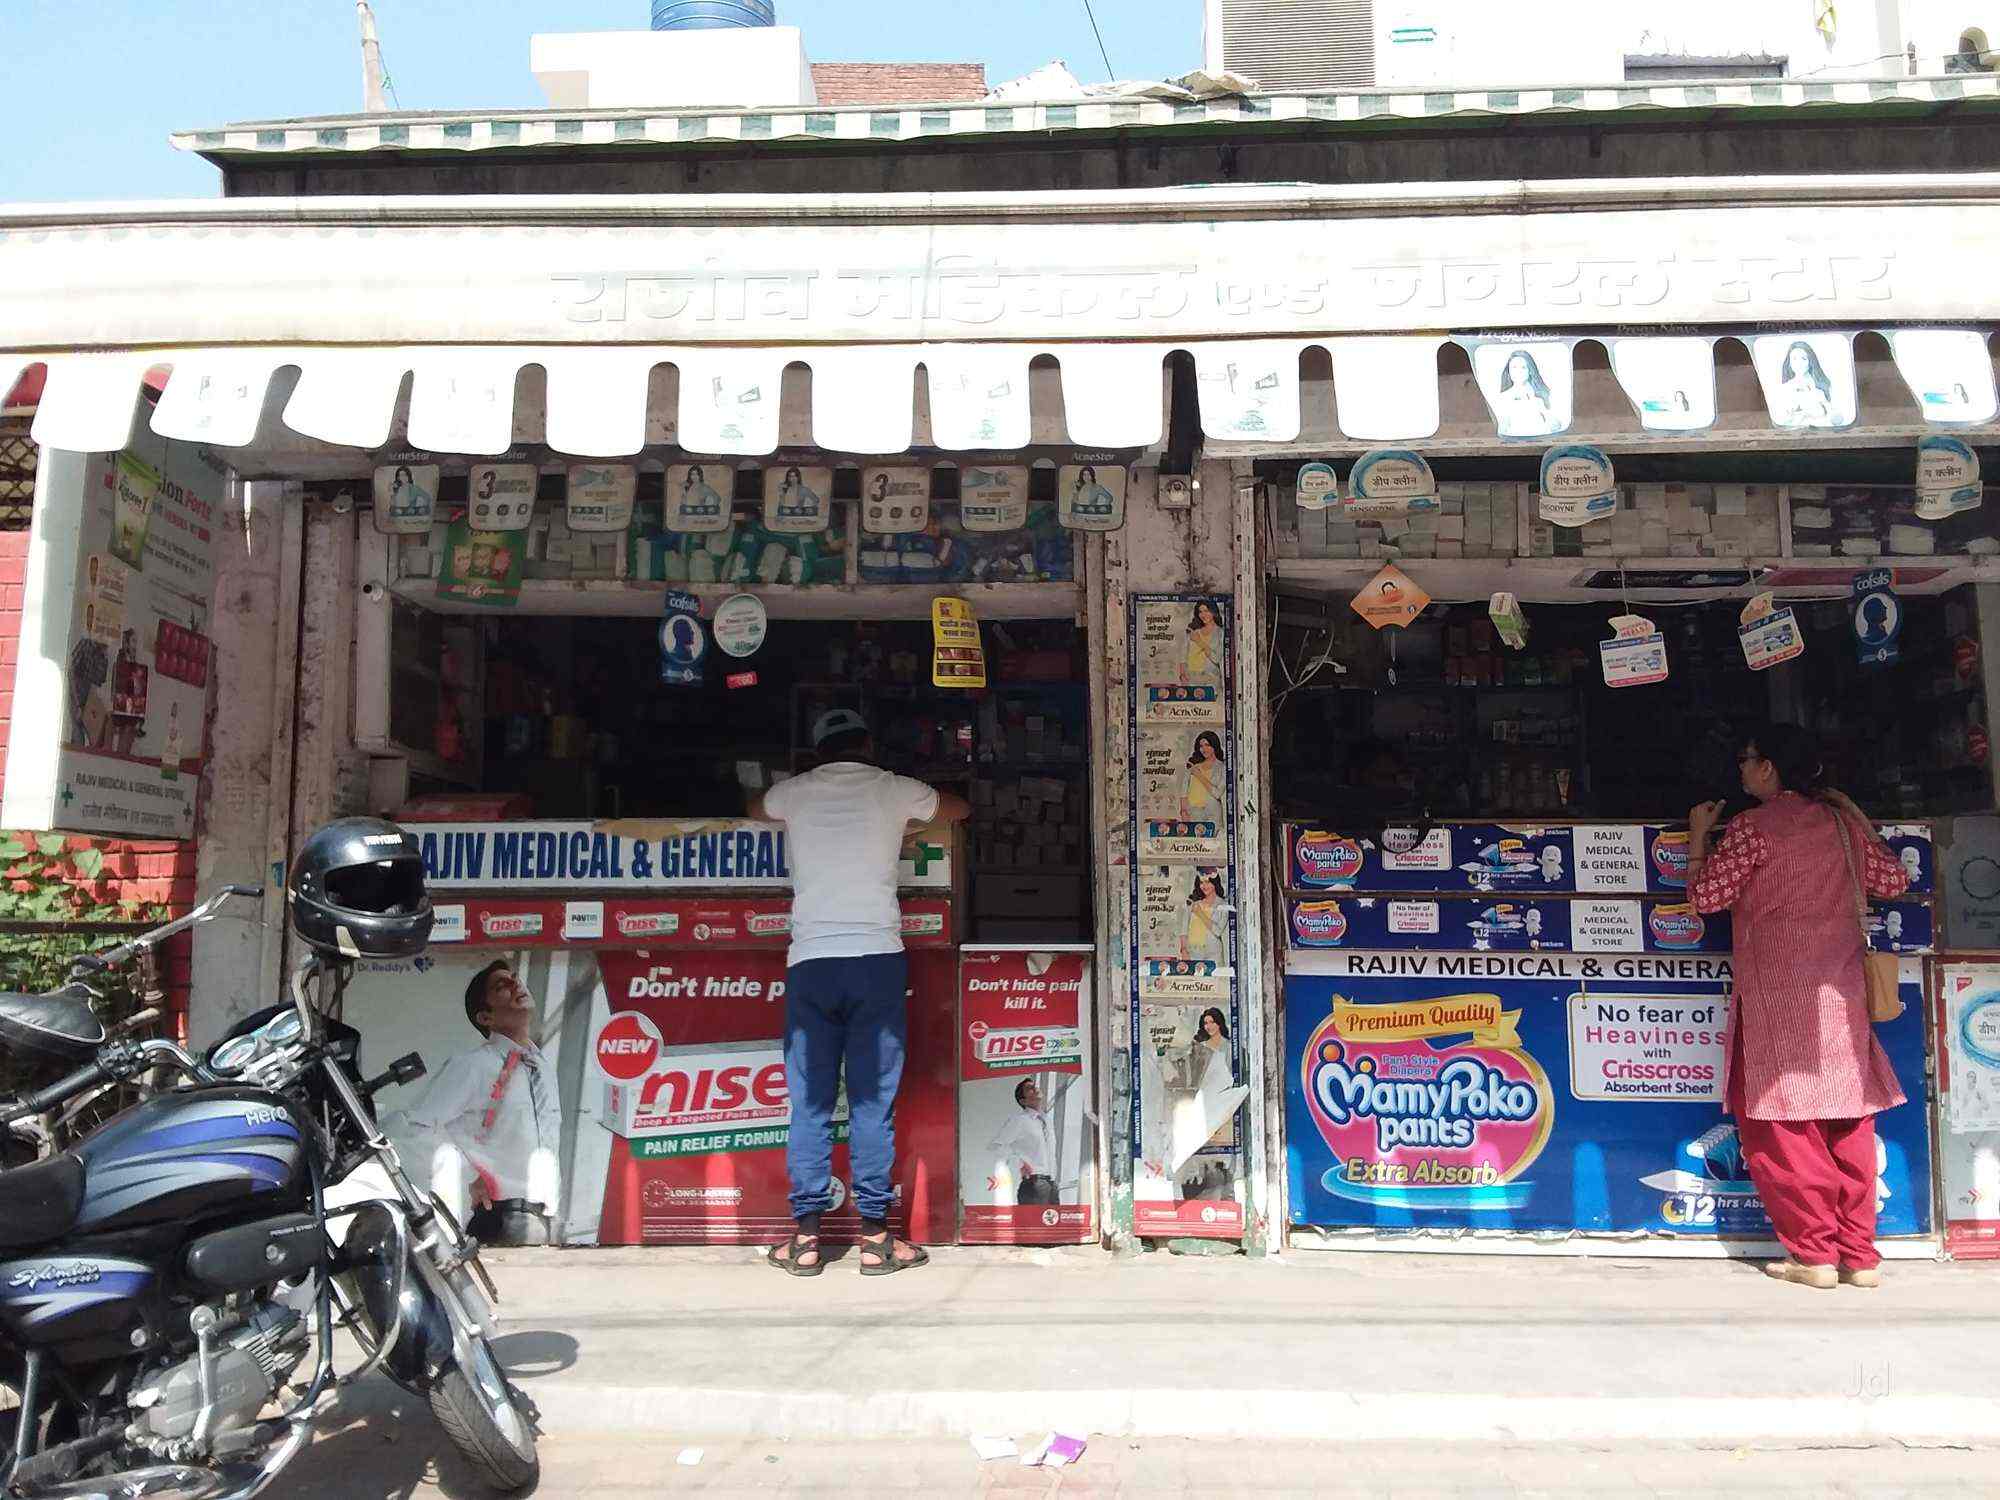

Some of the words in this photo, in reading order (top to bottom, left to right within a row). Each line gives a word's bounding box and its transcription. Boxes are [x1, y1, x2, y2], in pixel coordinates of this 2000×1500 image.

[479, 470, 496, 500] 3
[1573, 473, 1598, 486] क्लीन
[874, 473, 889, 501] 3
[98, 775, 127, 791] MEDICAL
[1149, 780, 1156, 792] 3
[1393, 832, 1406, 840] No
[1593, 831, 1624, 841] RAJIV
[492, 831, 624, 879] MEDICAL
[632, 839, 652, 878] &
[661, 831, 789, 878] GENERAL
[1300, 846, 1357, 862] MamyPoko
[1586, 845, 1633, 856] MEDICAL
[1395, 854, 1439, 862] Crisscross
[1316, 861, 1340, 869] pants
[1580, 860, 1589, 870] &
[1591, 860, 1640, 870] GENERAL
[1477, 872, 1490, 883] 12
[1593, 874, 1628, 885] STORE
[1592, 904, 1620, 914] RAJIV
[490, 919, 522, 931] nise
[625, 918, 657, 930] nise
[1297, 914, 1342, 928] MamyPoko
[1584, 916, 1629, 925] MEDICAL
[1479, 928, 1490, 937] 12
[1579, 926, 1588, 935] &
[1589, 926, 1635, 936] GENERAL
[1592, 937, 1624, 946] STORE
[1348, 956, 1428, 974] RAJIV
[1438, 957, 1572, 977] MEDICAL
[1582, 957, 1604, 977] &
[1614, 959, 1733, 980] GENERA
[629, 976, 698, 998] Don't
[704, 976, 762, 997] hide
[969, 978, 1008, 992] Don't
[1012, 978, 1045, 991] hide
[1169, 981, 1214, 992] AcneStar
[1004, 997, 1028, 1009] kill
[1346, 1010, 1425, 1032] Premium
[1429, 1003, 1495, 1026] Quality
[1598, 1005, 1630, 1022] No
[1639, 1005, 1683, 1023] fear
[1692, 1006, 1714, 1023] of
[1586, 1026, 1727, 1045] Heaviness
[600, 1039, 654, 1054] NEW
[987, 1034, 1045, 1053] nise
[1643, 1048, 1671, 1058] with
[1383, 1055, 1409, 1065] Pant
[1411, 1056, 1440, 1067] Style
[1390, 1066, 1432, 1077] Diapers
[1602, 1059, 1714, 1080] Crisscross
[640, 1062, 790, 1112] nise
[1316, 1056, 1537, 1124] MamyPoko
[1604, 1081, 1672, 1093] Absorbent
[1675, 1081, 1714, 1094] Sheet
[245, 1106, 287, 1126] Hero
[1379, 1115, 1474, 1151] pants
[645, 1140, 678, 1154] PAIN
[681, 1134, 731, 1151] RELIEF
[1347, 1158, 1409, 1183] Extra
[1413, 1159, 1498, 1184] Absorb
[1684, 1195, 1716, 1223] 12
[1717, 1196, 1739, 1208] hrs
